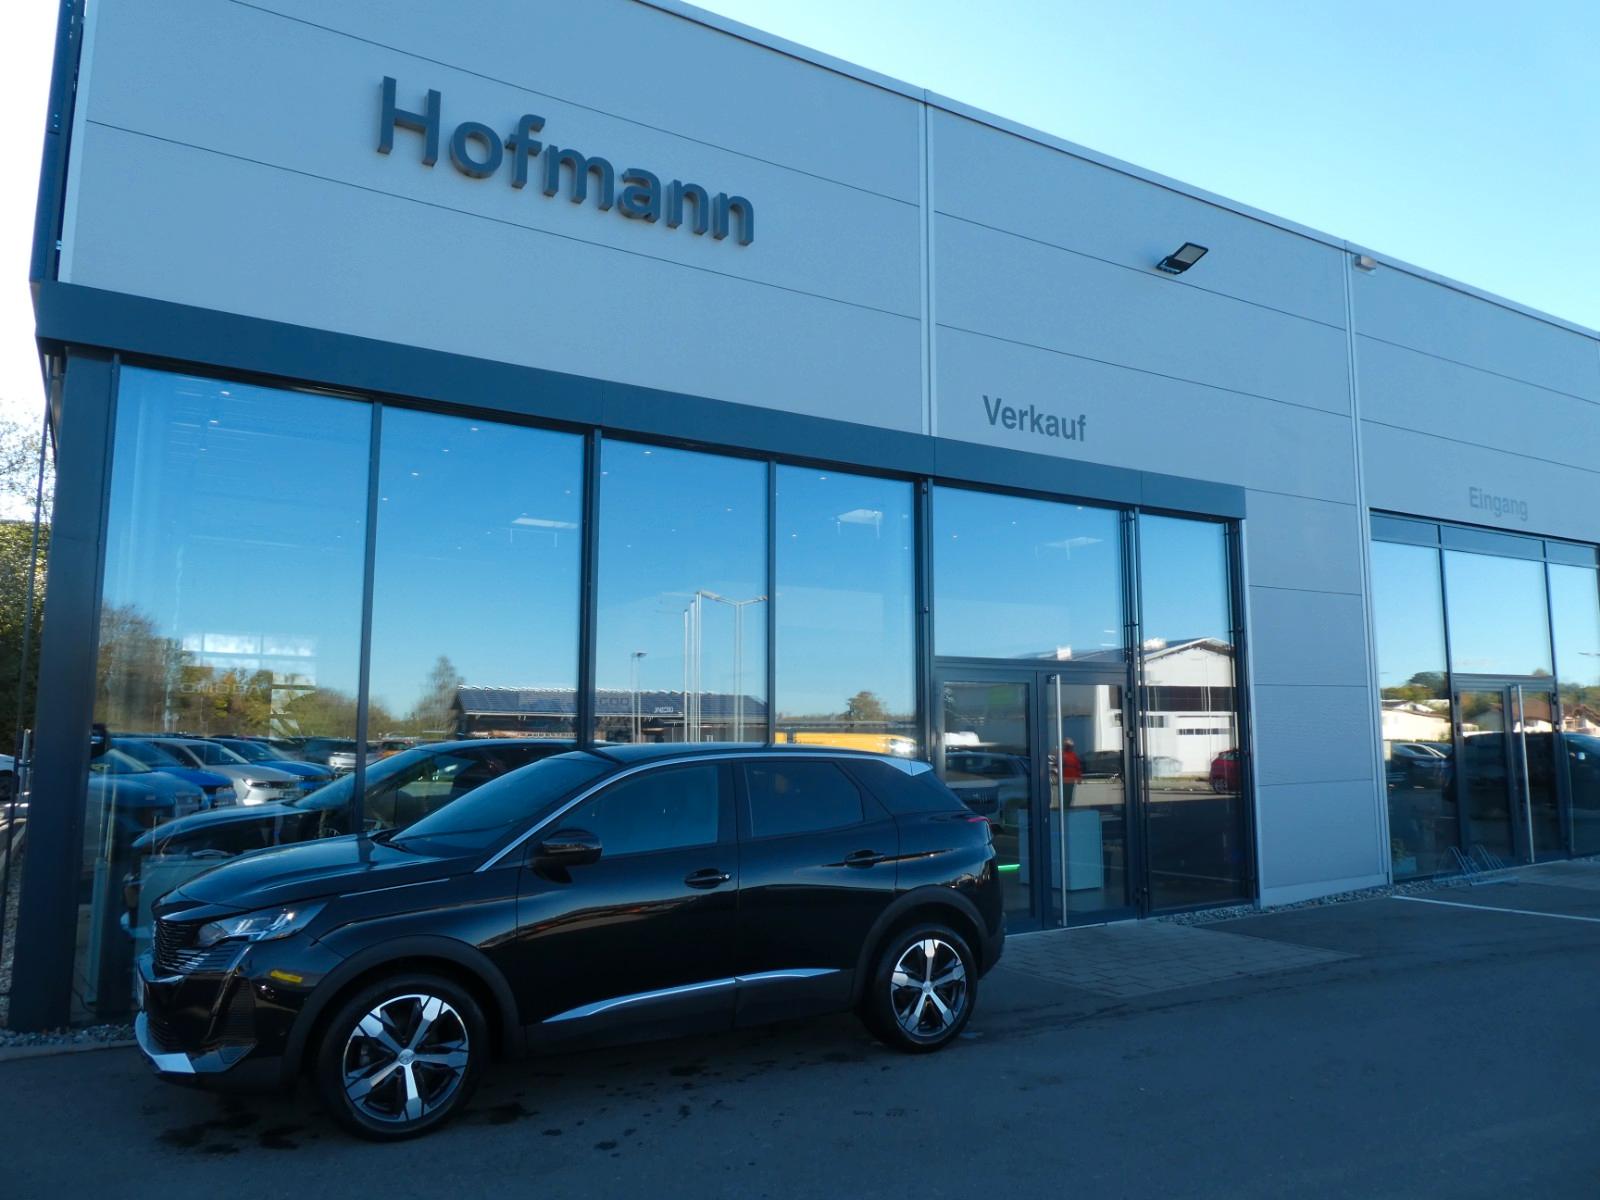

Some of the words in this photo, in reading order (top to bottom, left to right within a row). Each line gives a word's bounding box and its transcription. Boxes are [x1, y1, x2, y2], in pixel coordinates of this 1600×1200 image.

[377, 76, 755, 246] Hofmann
[982, 394, 1087, 442] Verkauf
[1469, 486, 1529, 522] Eingang
